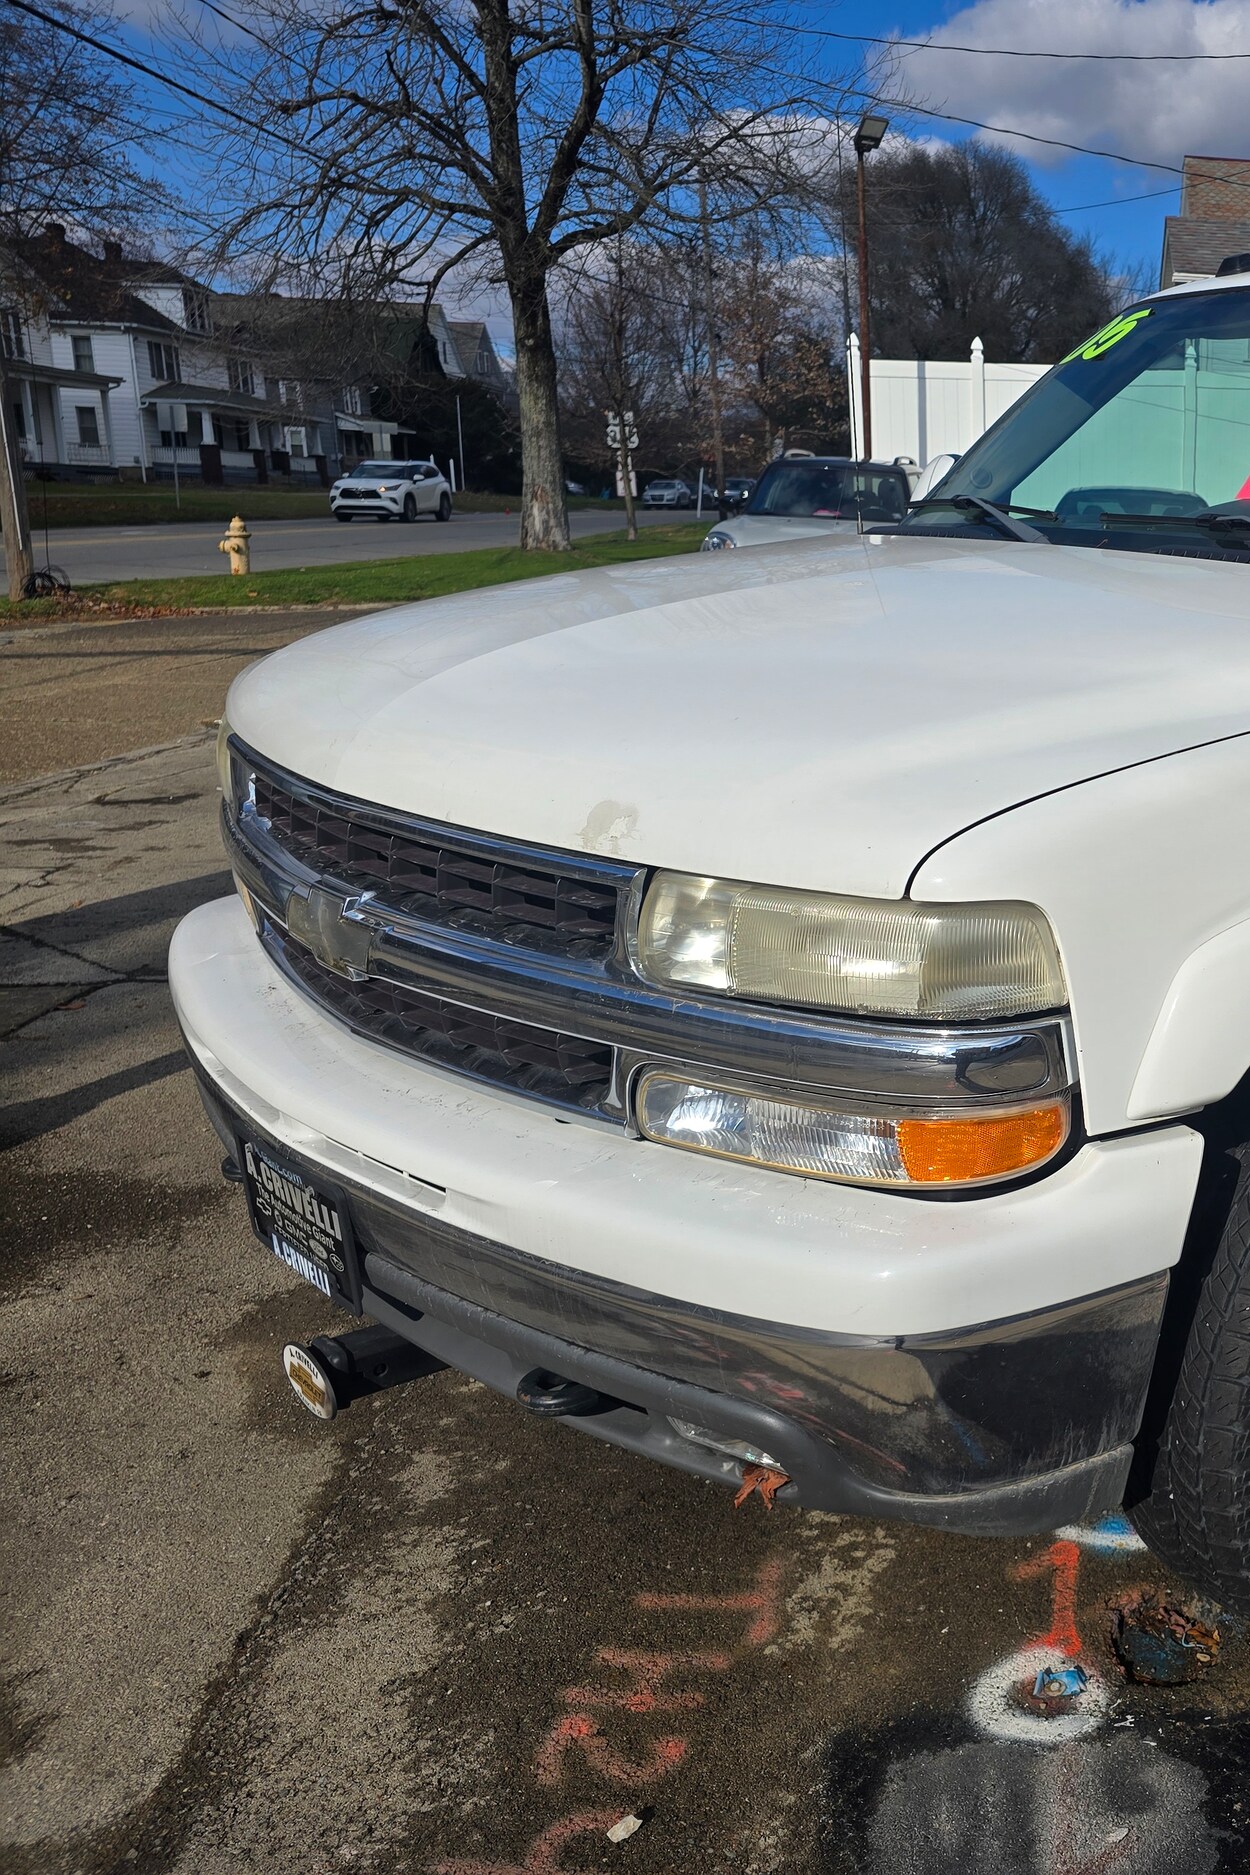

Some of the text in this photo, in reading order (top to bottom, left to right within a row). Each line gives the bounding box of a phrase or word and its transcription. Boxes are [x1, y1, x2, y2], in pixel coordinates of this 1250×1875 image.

[256, 1181, 270, 1203] The
[271, 1193, 312, 1235] Automotive
[312, 1226, 335, 1251] Giant
[285, 1219, 309, 1246] GMC
[272, 1233, 331, 1297] A.CRIVELLI
